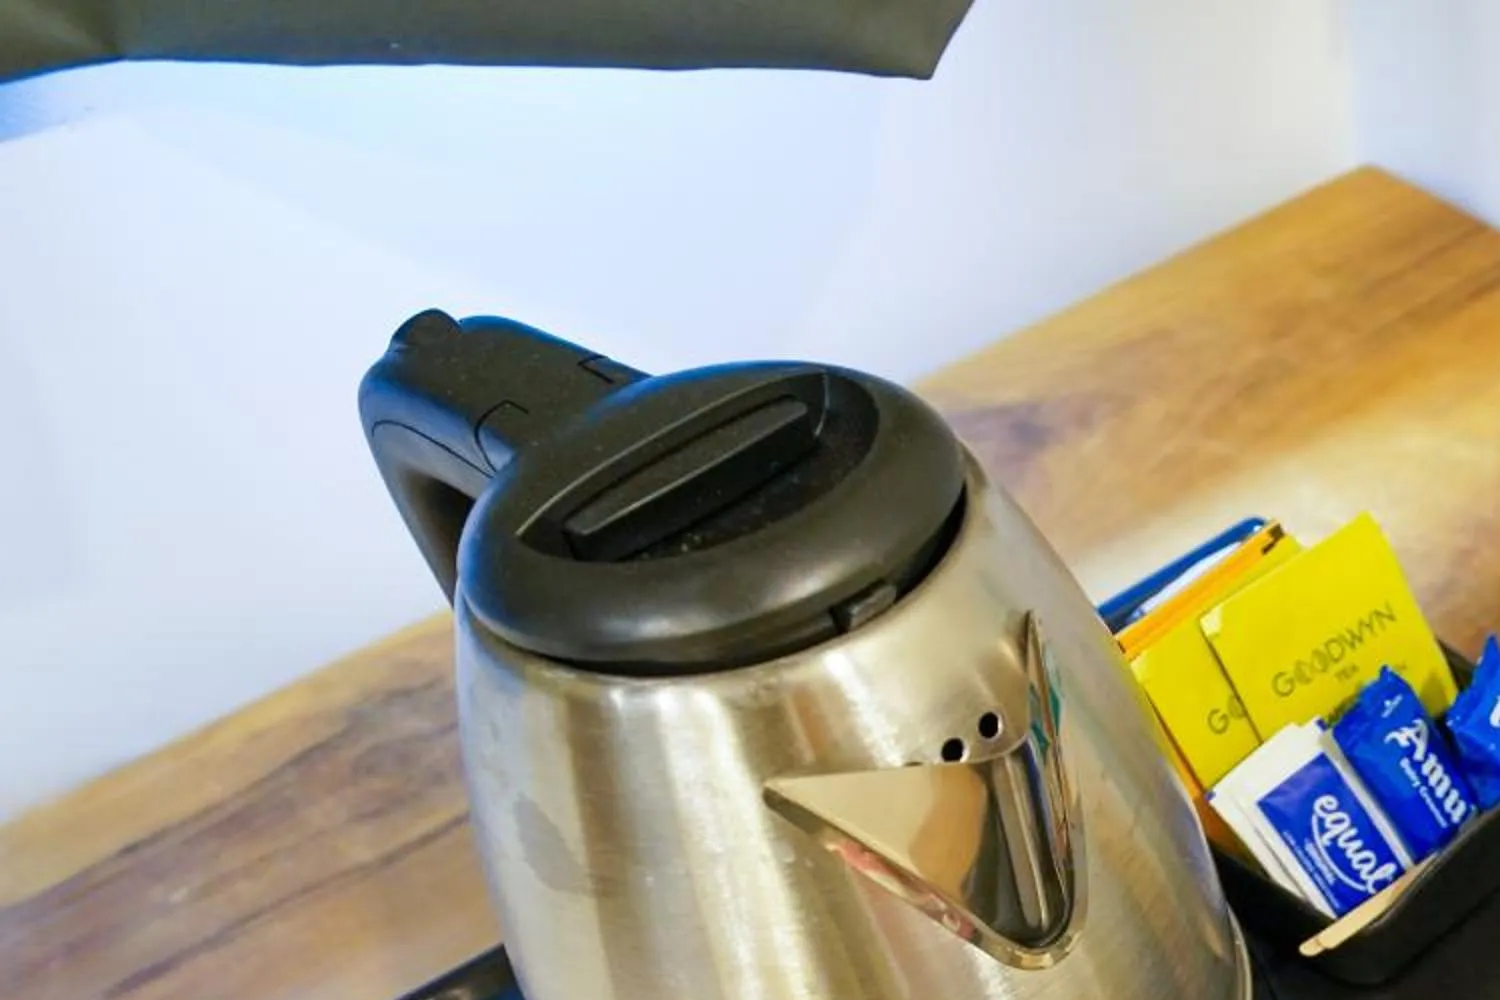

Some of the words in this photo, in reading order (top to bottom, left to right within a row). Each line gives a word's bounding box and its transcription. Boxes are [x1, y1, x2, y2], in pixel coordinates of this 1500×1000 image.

[1271, 601, 1397, 697] GOODWYN
[1383, 718, 1477, 824] Amu
[1312, 794, 1398, 894] equal
